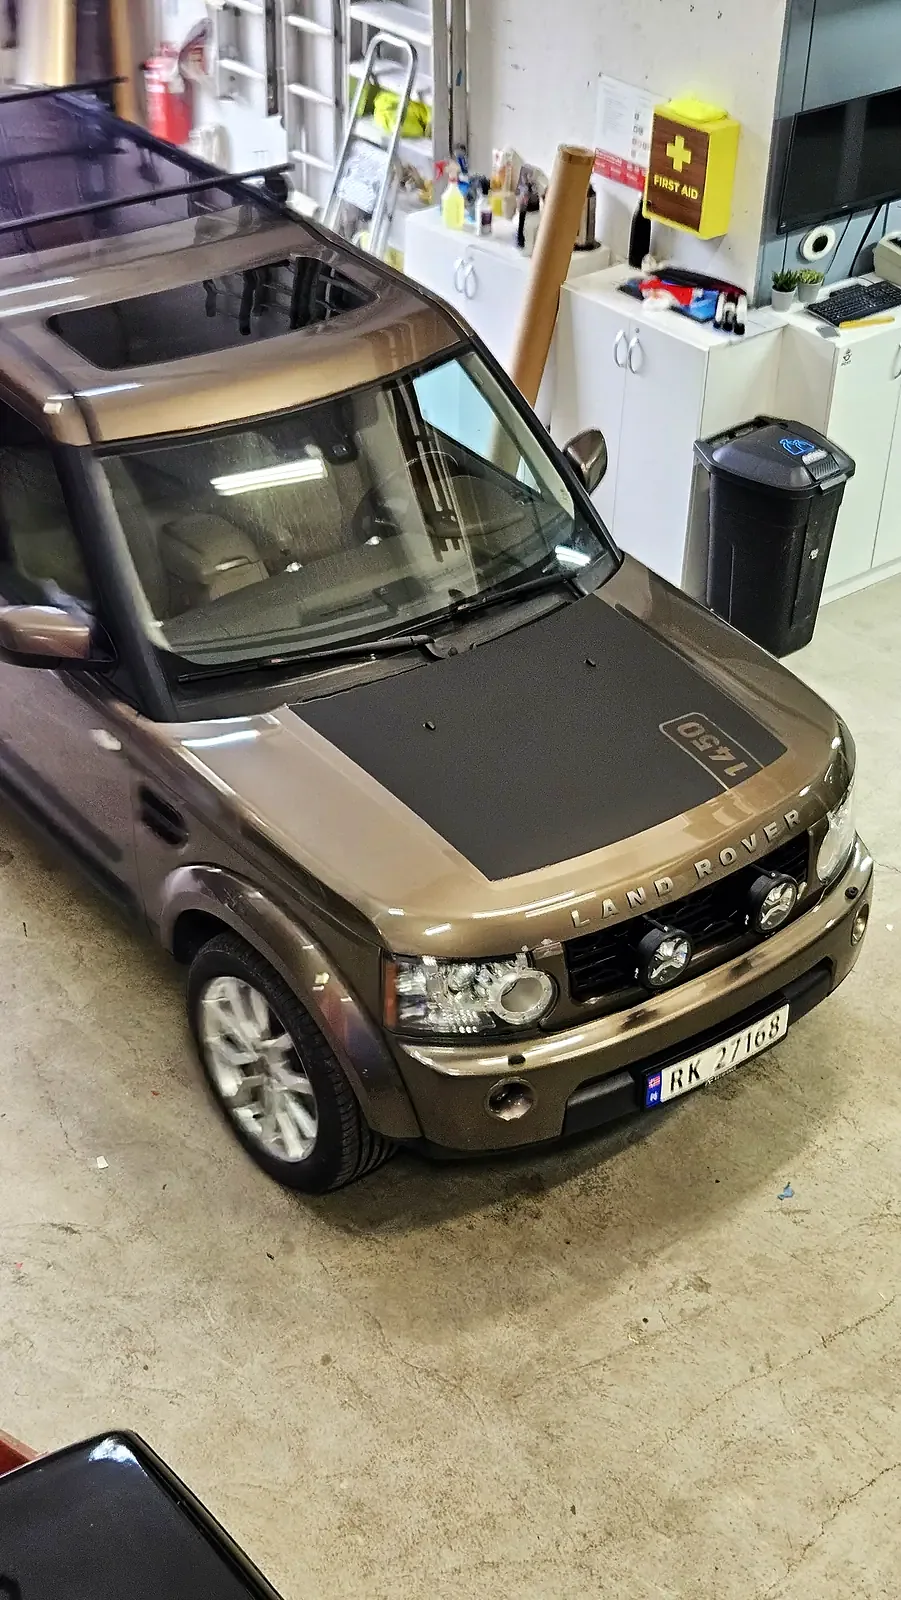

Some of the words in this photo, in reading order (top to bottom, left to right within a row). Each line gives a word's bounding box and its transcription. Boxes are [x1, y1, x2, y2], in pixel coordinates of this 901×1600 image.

[653, 174, 680, 192] FIRST
[681, 185, 699, 199] AID
[677, 721, 749, 777] 1450
[570, 876, 674, 929] LAND
[693, 809, 801, 880] ROVER
[670, 1059, 701, 1092] RK
[715, 1015, 780, 1071] 27168
